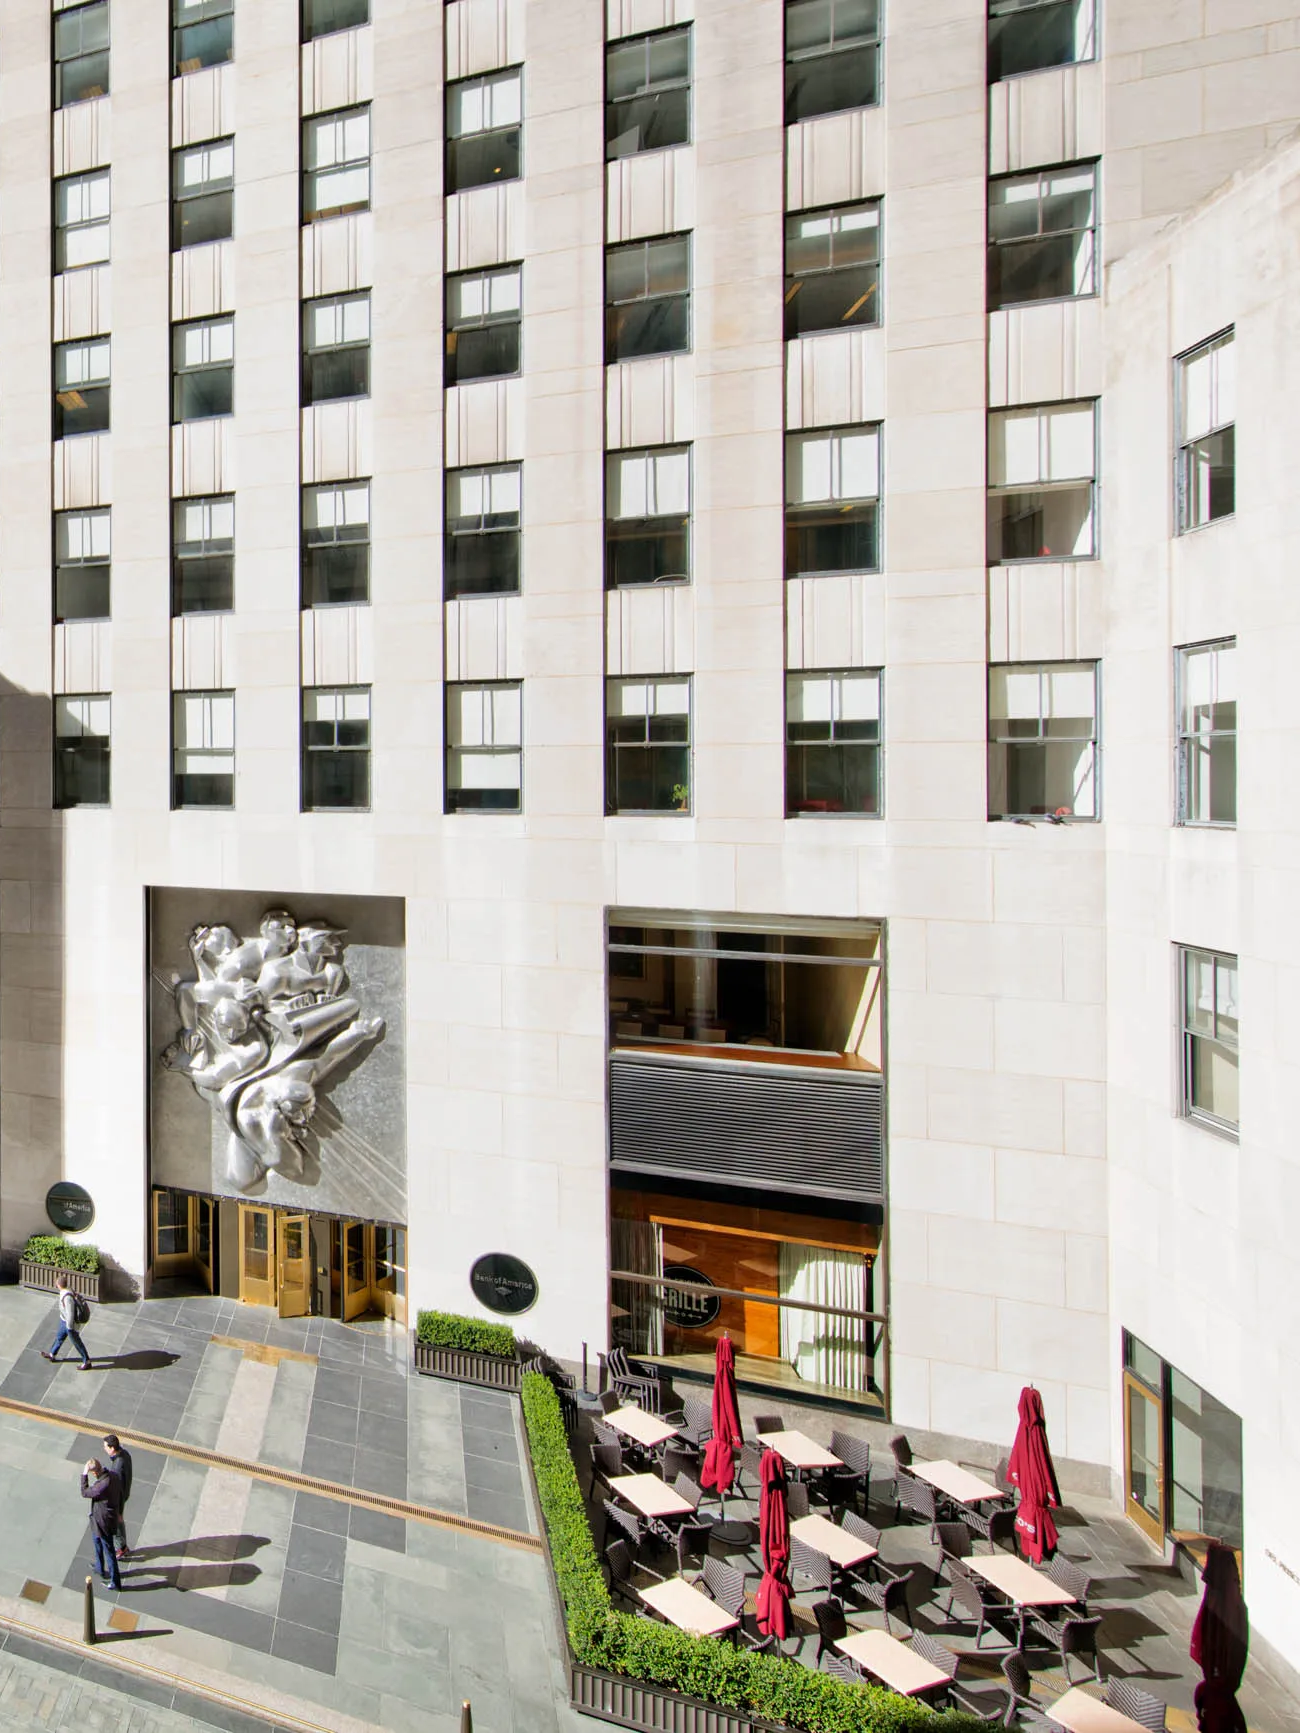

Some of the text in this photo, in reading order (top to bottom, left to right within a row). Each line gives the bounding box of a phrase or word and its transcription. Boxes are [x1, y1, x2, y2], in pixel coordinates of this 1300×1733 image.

[475, 1273, 533, 1290] Bank of America
